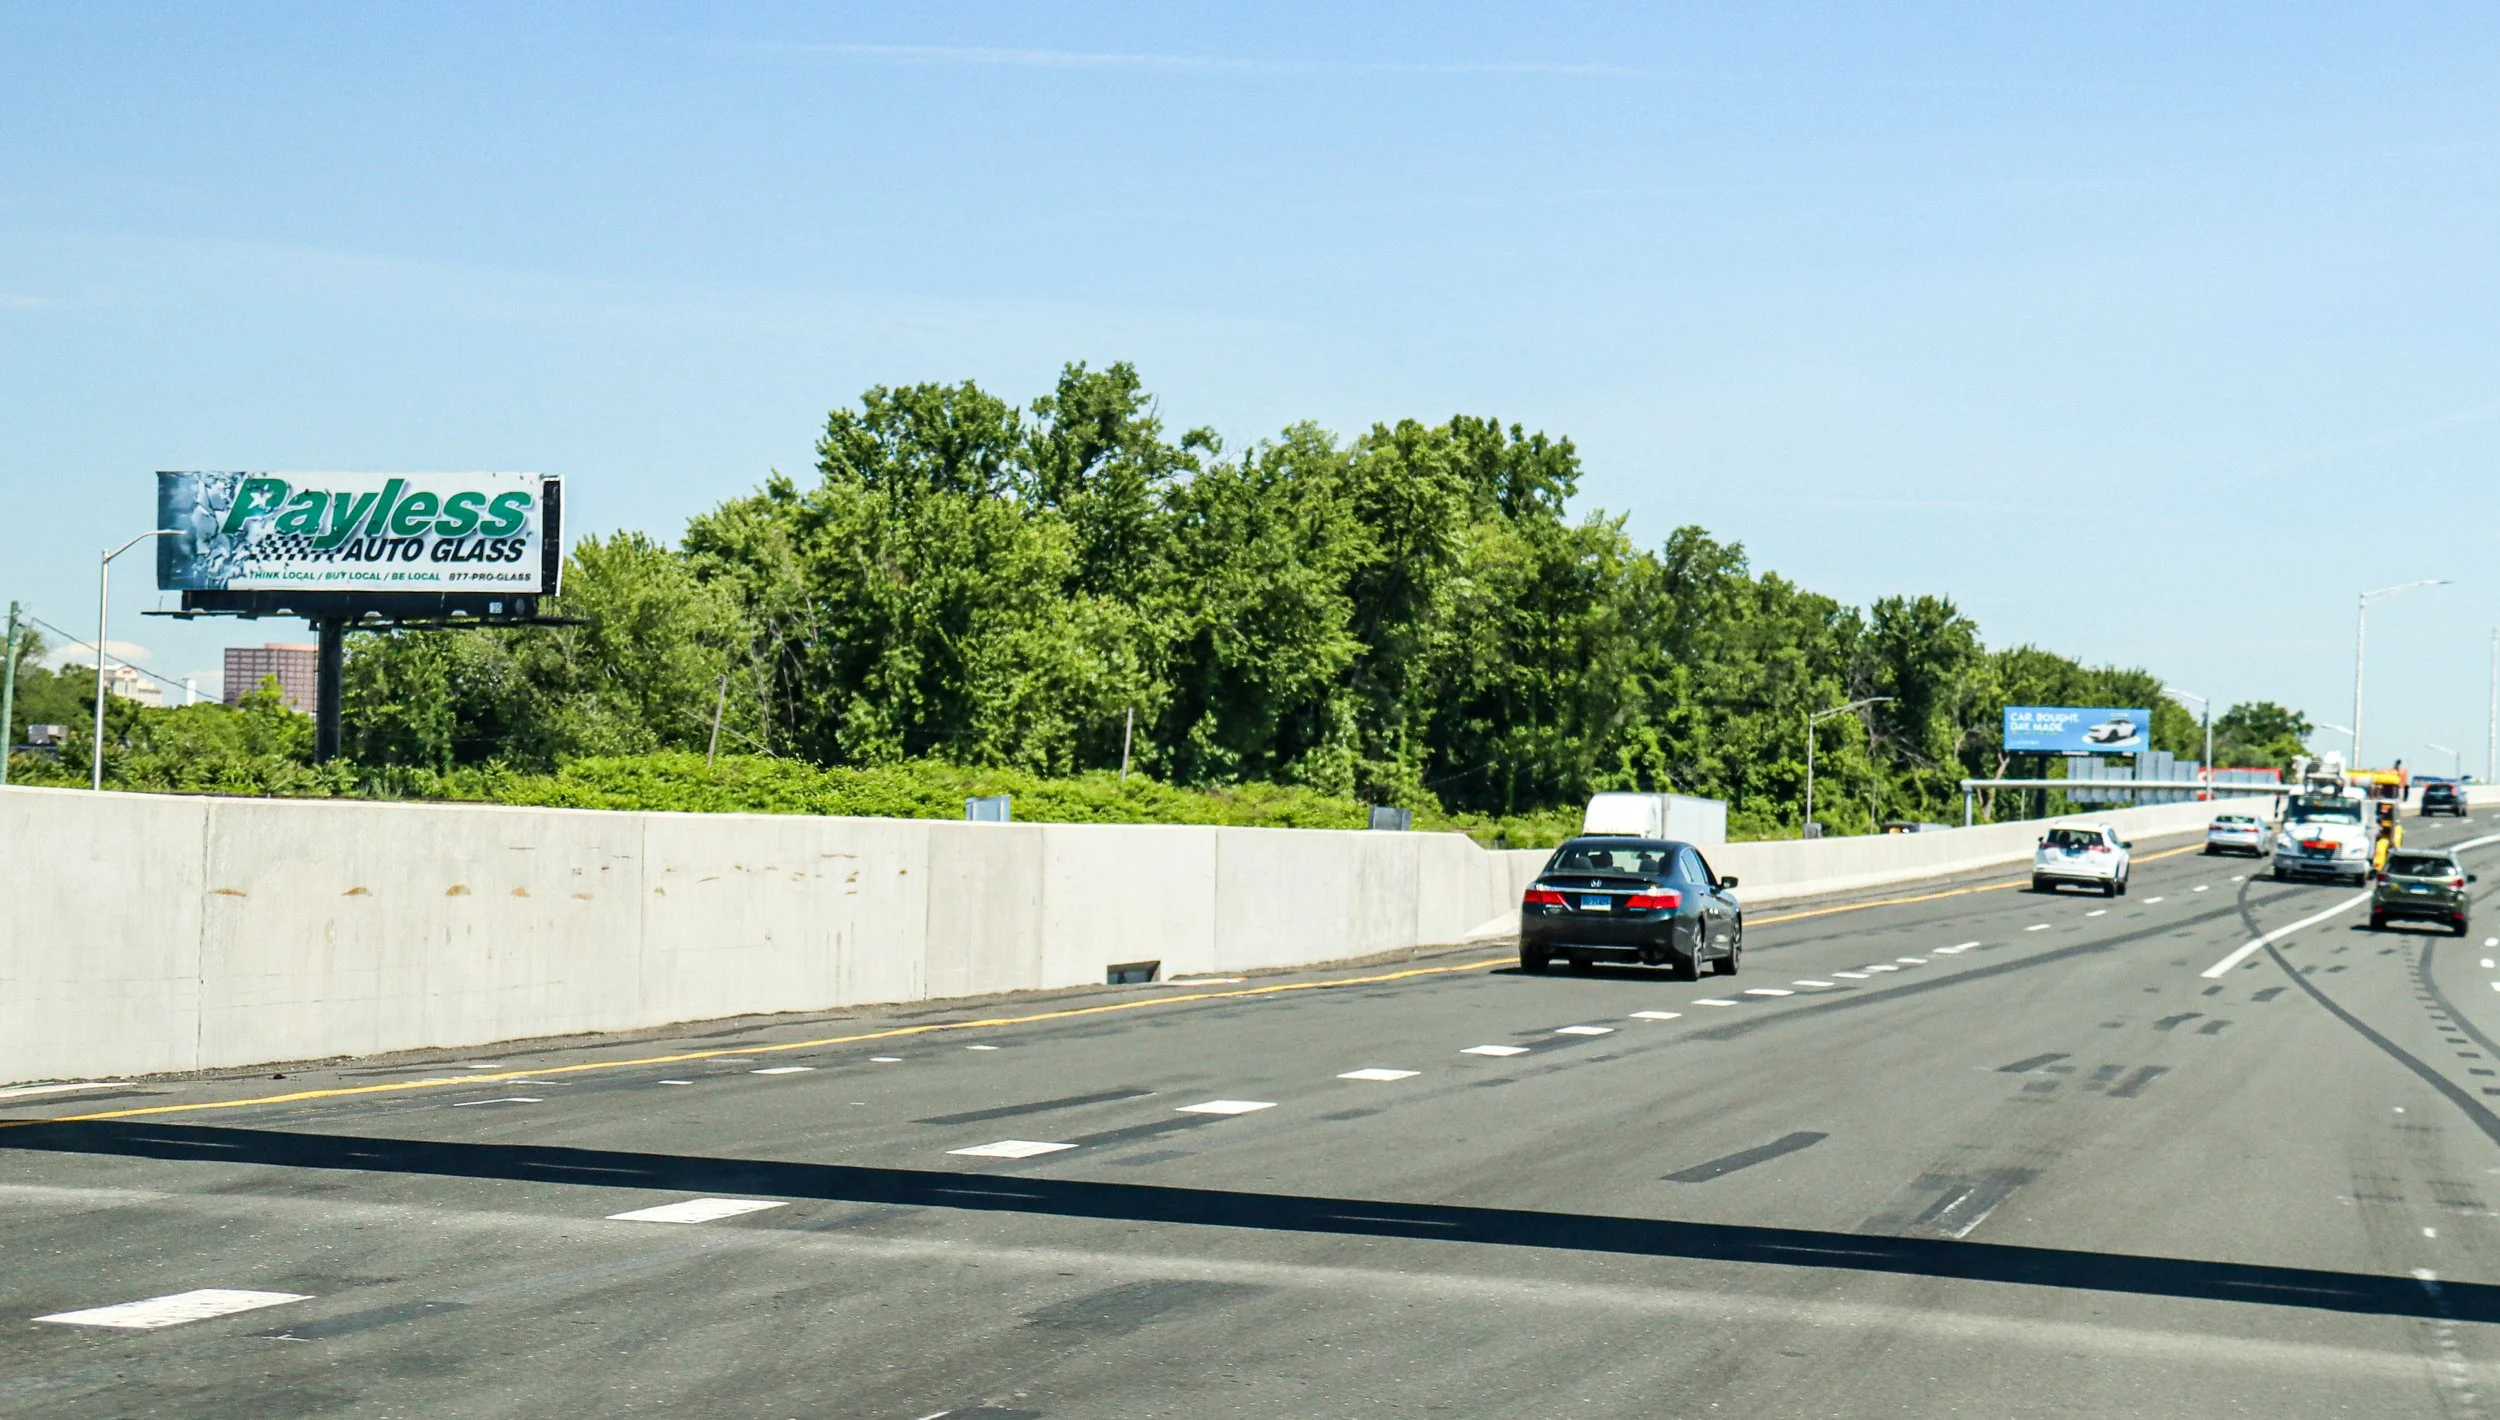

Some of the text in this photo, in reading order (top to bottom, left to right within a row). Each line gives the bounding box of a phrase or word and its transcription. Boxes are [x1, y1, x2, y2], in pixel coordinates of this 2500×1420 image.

[222, 478, 532, 550] Payless
[342, 537, 525, 562] AUTO GLASS
[250, 571, 280, 580] THINK
[283, 572, 315, 580] LOCAL
[325, 572, 346, 580] BUY
[349, 572, 380, 580] LOCAL
[392, 572, 405, 580] BE
[407, 572, 440, 580] LOCAL
[448, 573, 531, 581] 877-PRO-GLASS
